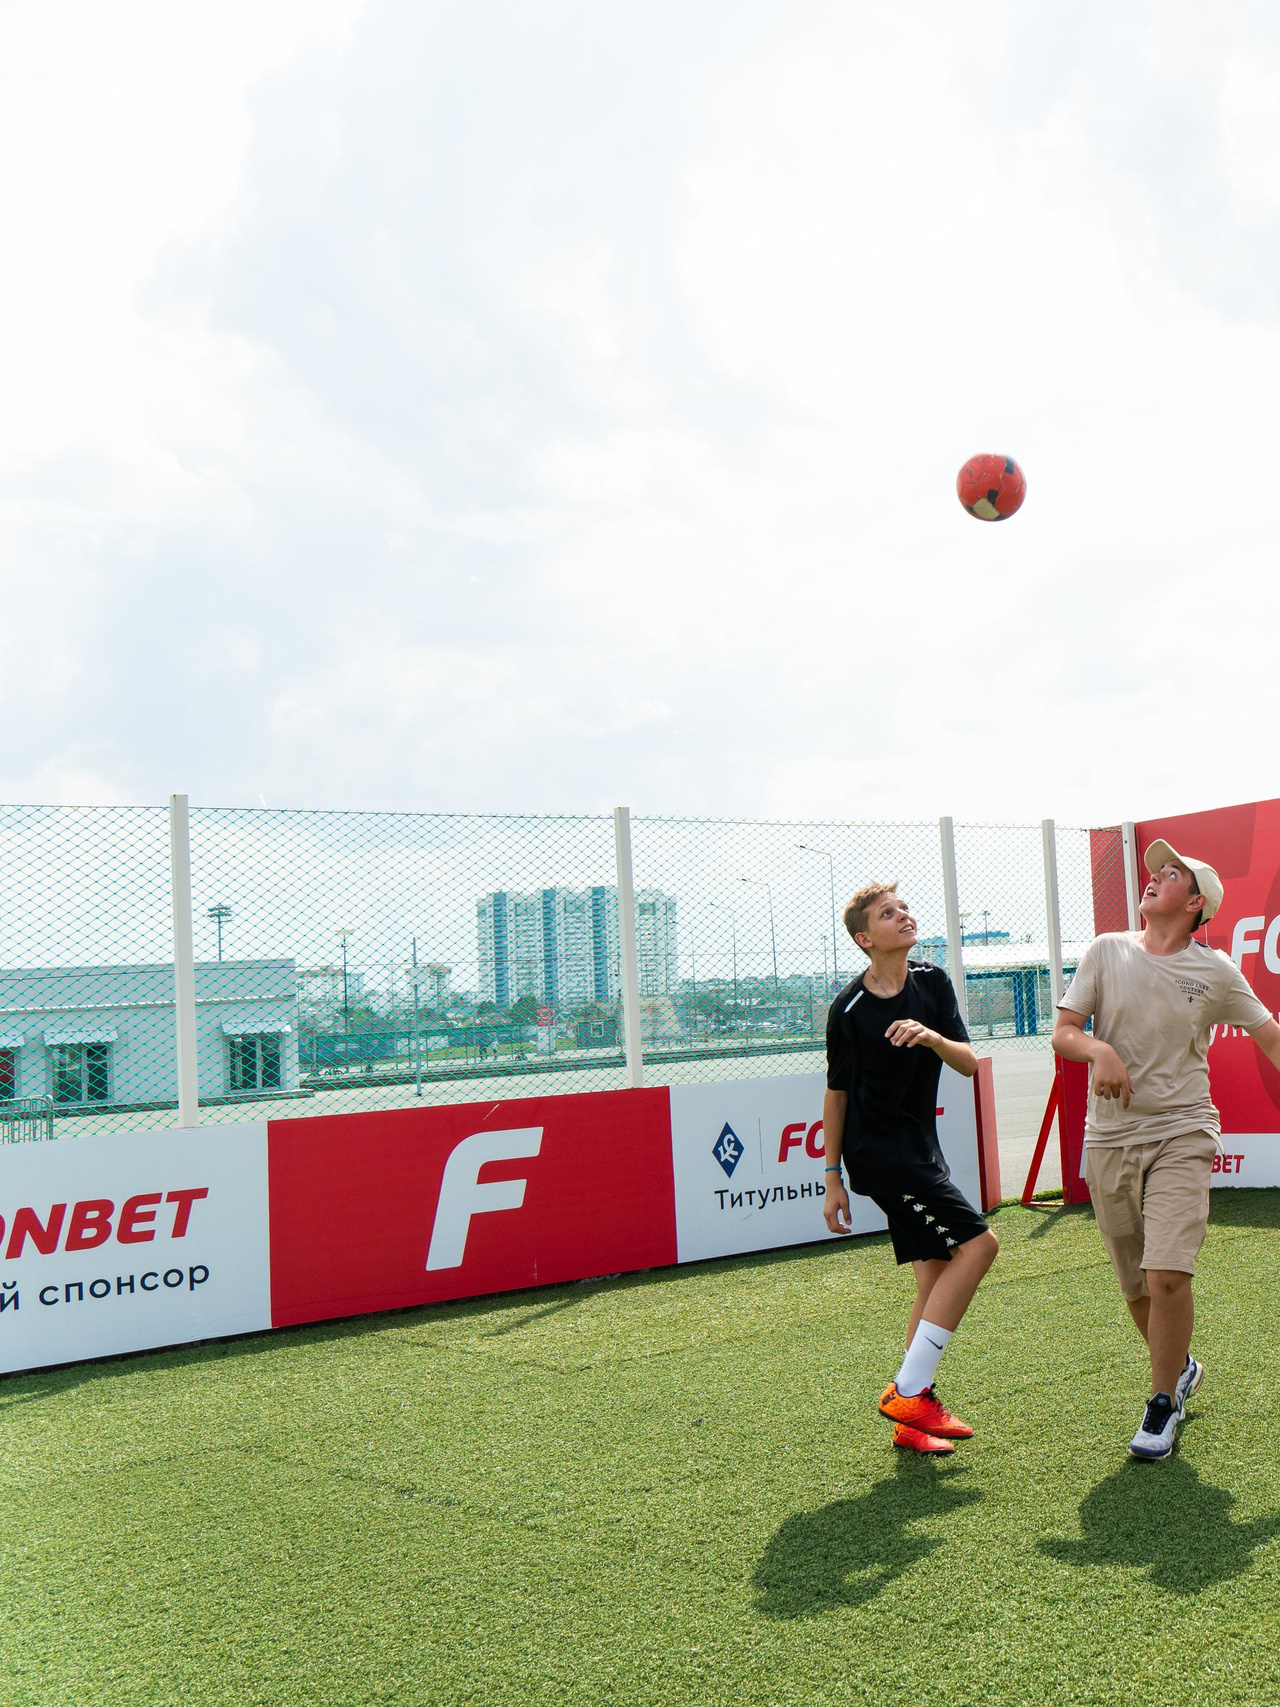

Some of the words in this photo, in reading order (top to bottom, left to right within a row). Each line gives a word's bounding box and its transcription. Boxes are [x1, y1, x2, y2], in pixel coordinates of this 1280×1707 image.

[0, 1187, 209, 1260] NBET
[426, 1126, 544, 1271] F
[39, 1265, 209, 1308] спонсор
